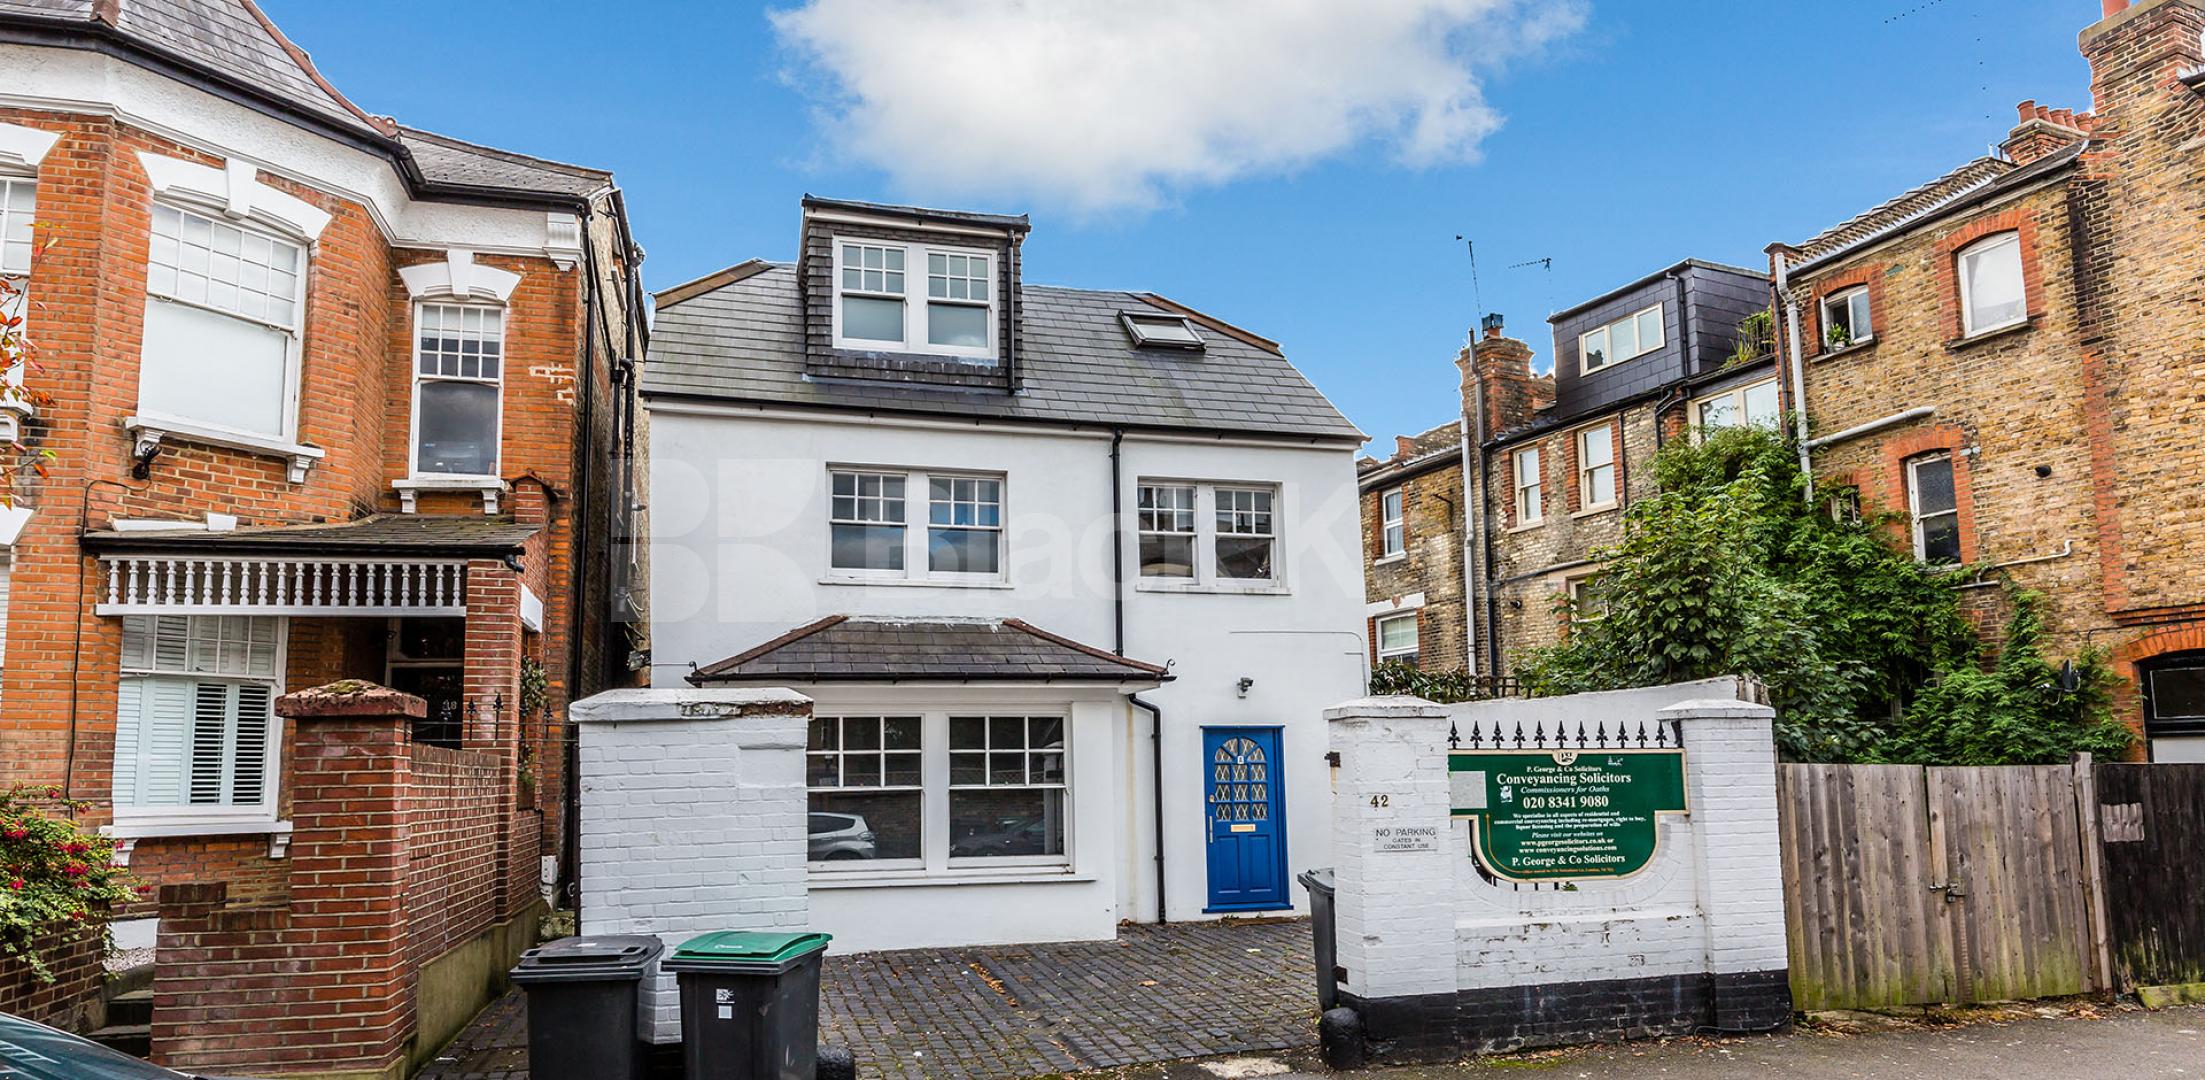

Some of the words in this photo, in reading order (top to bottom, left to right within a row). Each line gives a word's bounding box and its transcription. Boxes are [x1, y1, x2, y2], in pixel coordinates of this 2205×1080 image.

[1496, 773, 1577, 787] Conveyancing
[1579, 772, 1632, 784] Solicitors
[1520, 786, 1575, 794] Commissioners
[1574, 786, 1587, 795] for
[1588, 785, 1610, 793] Oaths
[1370, 794, 1389, 808] 42
[1523, 796, 1545, 809] 020
[1547, 796, 1576, 808] 8341
[1579, 795, 1609, 808] 9080
[1375, 828, 1391, 837] NO
[1395, 827, 1437, 837] PARKING
[1511, 857, 1521, 867] P.
[1522, 856, 1556, 868] George
[1557, 855, 1567, 865] &
[1568, 855, 1582, 865] Co
[1583, 854, 1626, 864] Solicitors
